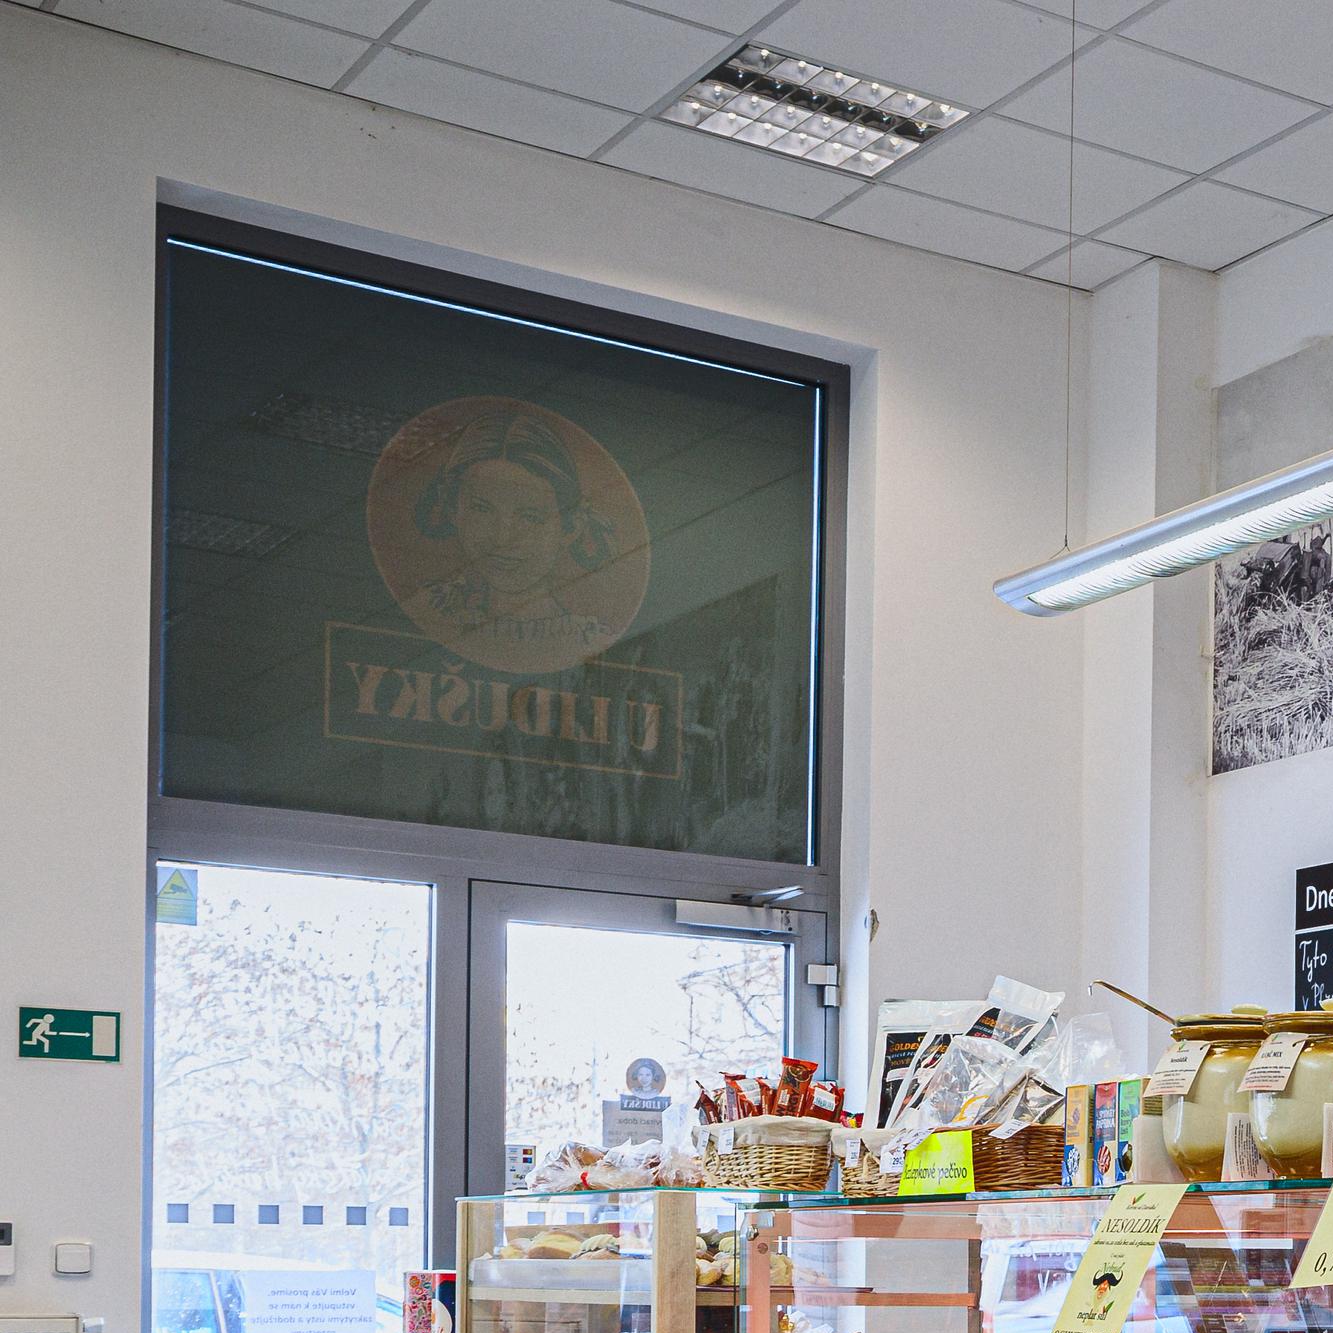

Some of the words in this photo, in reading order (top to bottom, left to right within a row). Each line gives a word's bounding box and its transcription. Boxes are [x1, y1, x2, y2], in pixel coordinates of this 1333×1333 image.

[1299, 940, 1327, 982] Tyto
[937, 1162, 967, 1184] pečivo
[1102, 1216, 1165, 1233] NESOLDÍK
